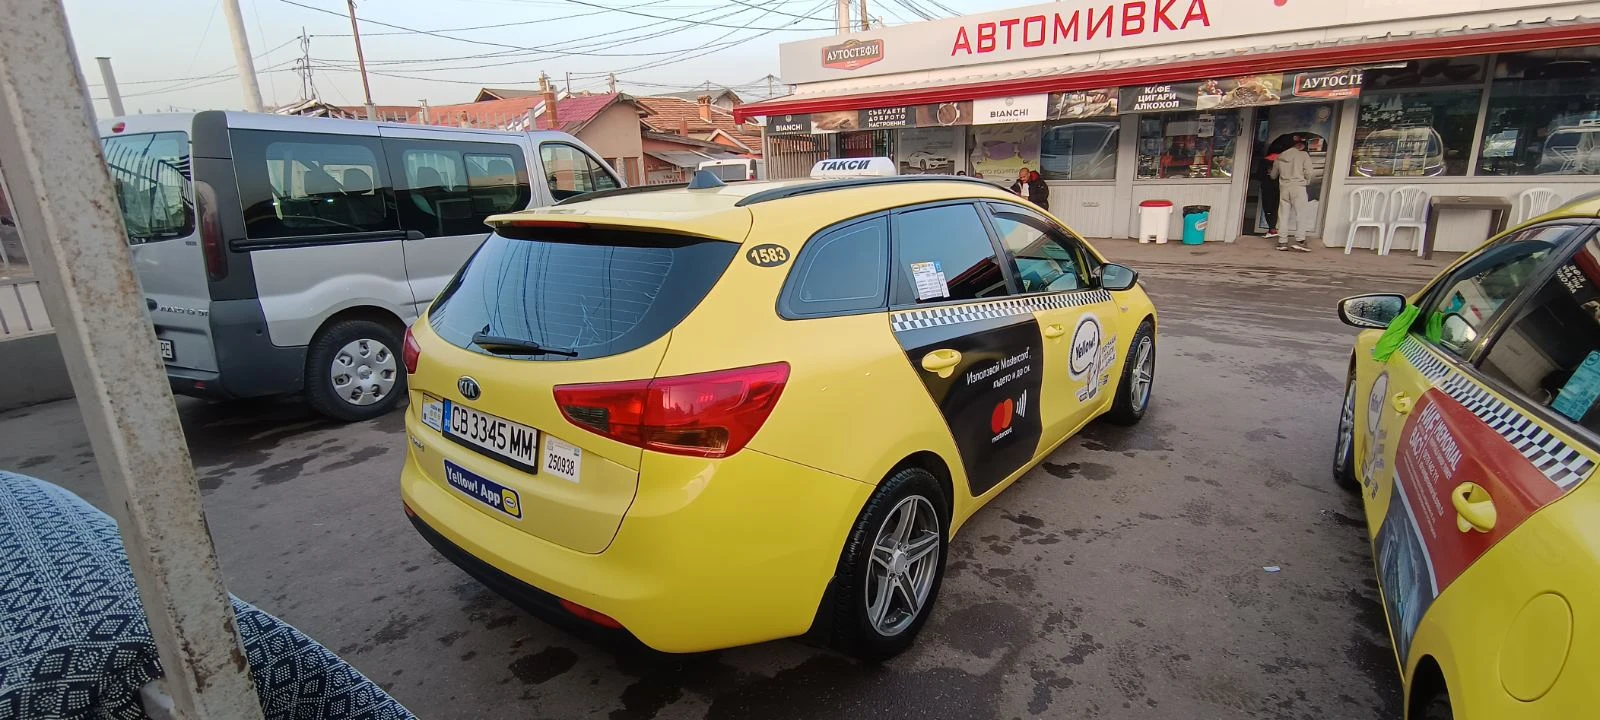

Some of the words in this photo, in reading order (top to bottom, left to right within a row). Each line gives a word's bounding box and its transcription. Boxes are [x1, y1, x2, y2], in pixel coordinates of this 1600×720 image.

[951, 0, 1211, 57] АВТОМИВКА
[827, 44, 880, 61] АУТОСТЕФИ
[1133, 100, 1180, 111] АЛКОХОЛ
[1138, 92, 1177, 103] ЦИГАРИ
[868, 107, 906, 116] СЪБУДЕТЕ
[868, 113, 906, 122] ДОБРОТО
[990, 108, 1029, 118] BIANCHI
[775, 123, 803, 132] BIANCHI
[868, 120, 906, 128] НАСТРОЕНИЕ
[820, 159, 872, 171] ТАКСИ
[751, 246, 787, 264] 1583
[1075, 331, 1096, 361] Yellow!
[966, 361, 1000, 386] Използвай
[993, 374, 1012, 389] където
[1016, 368, 1023, 379] до
[459, 379, 476, 397] KIA
[452, 406, 468, 436] CB
[470, 413, 507, 450] 3345
[509, 425, 534, 461] MM
[1433, 419, 1462, 472] MEMORIAL
[548, 453, 575, 477] 250938
[446, 465, 478, 494] Yellow!
[481, 486, 501, 507] App
